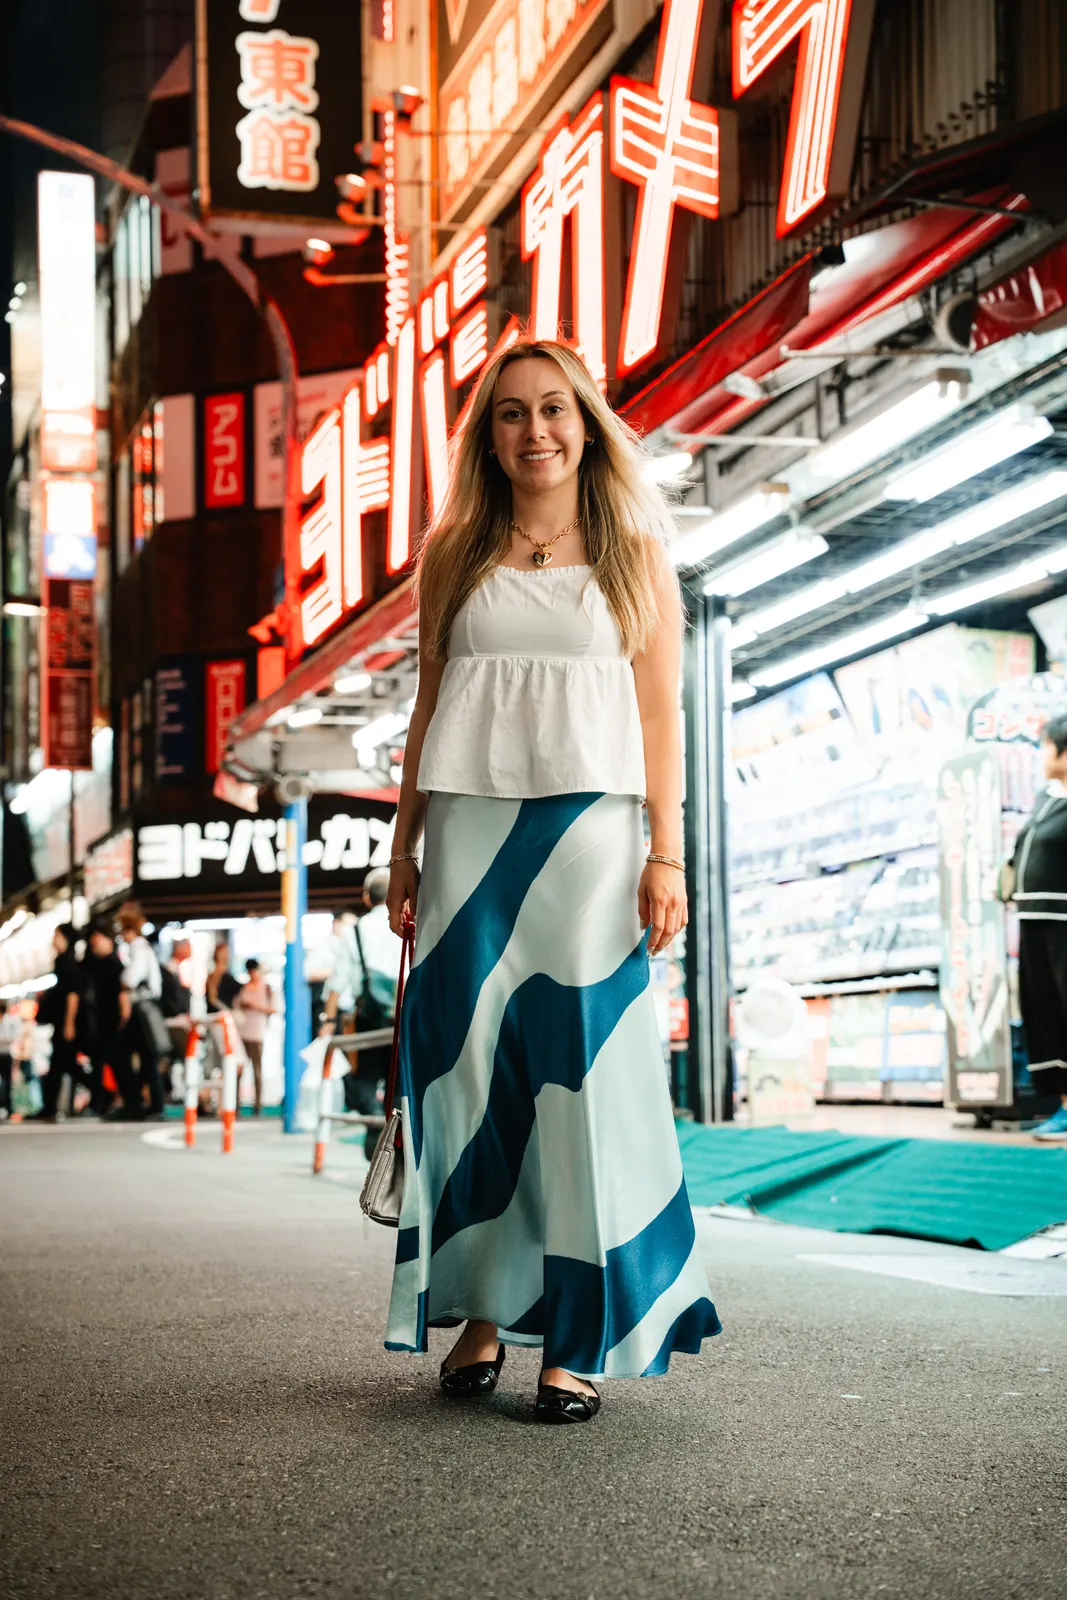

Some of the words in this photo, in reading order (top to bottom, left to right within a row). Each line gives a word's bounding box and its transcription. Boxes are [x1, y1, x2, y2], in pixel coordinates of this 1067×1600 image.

[235, 0, 321, 192] 東館
[212, 403, 238, 496] アコム
